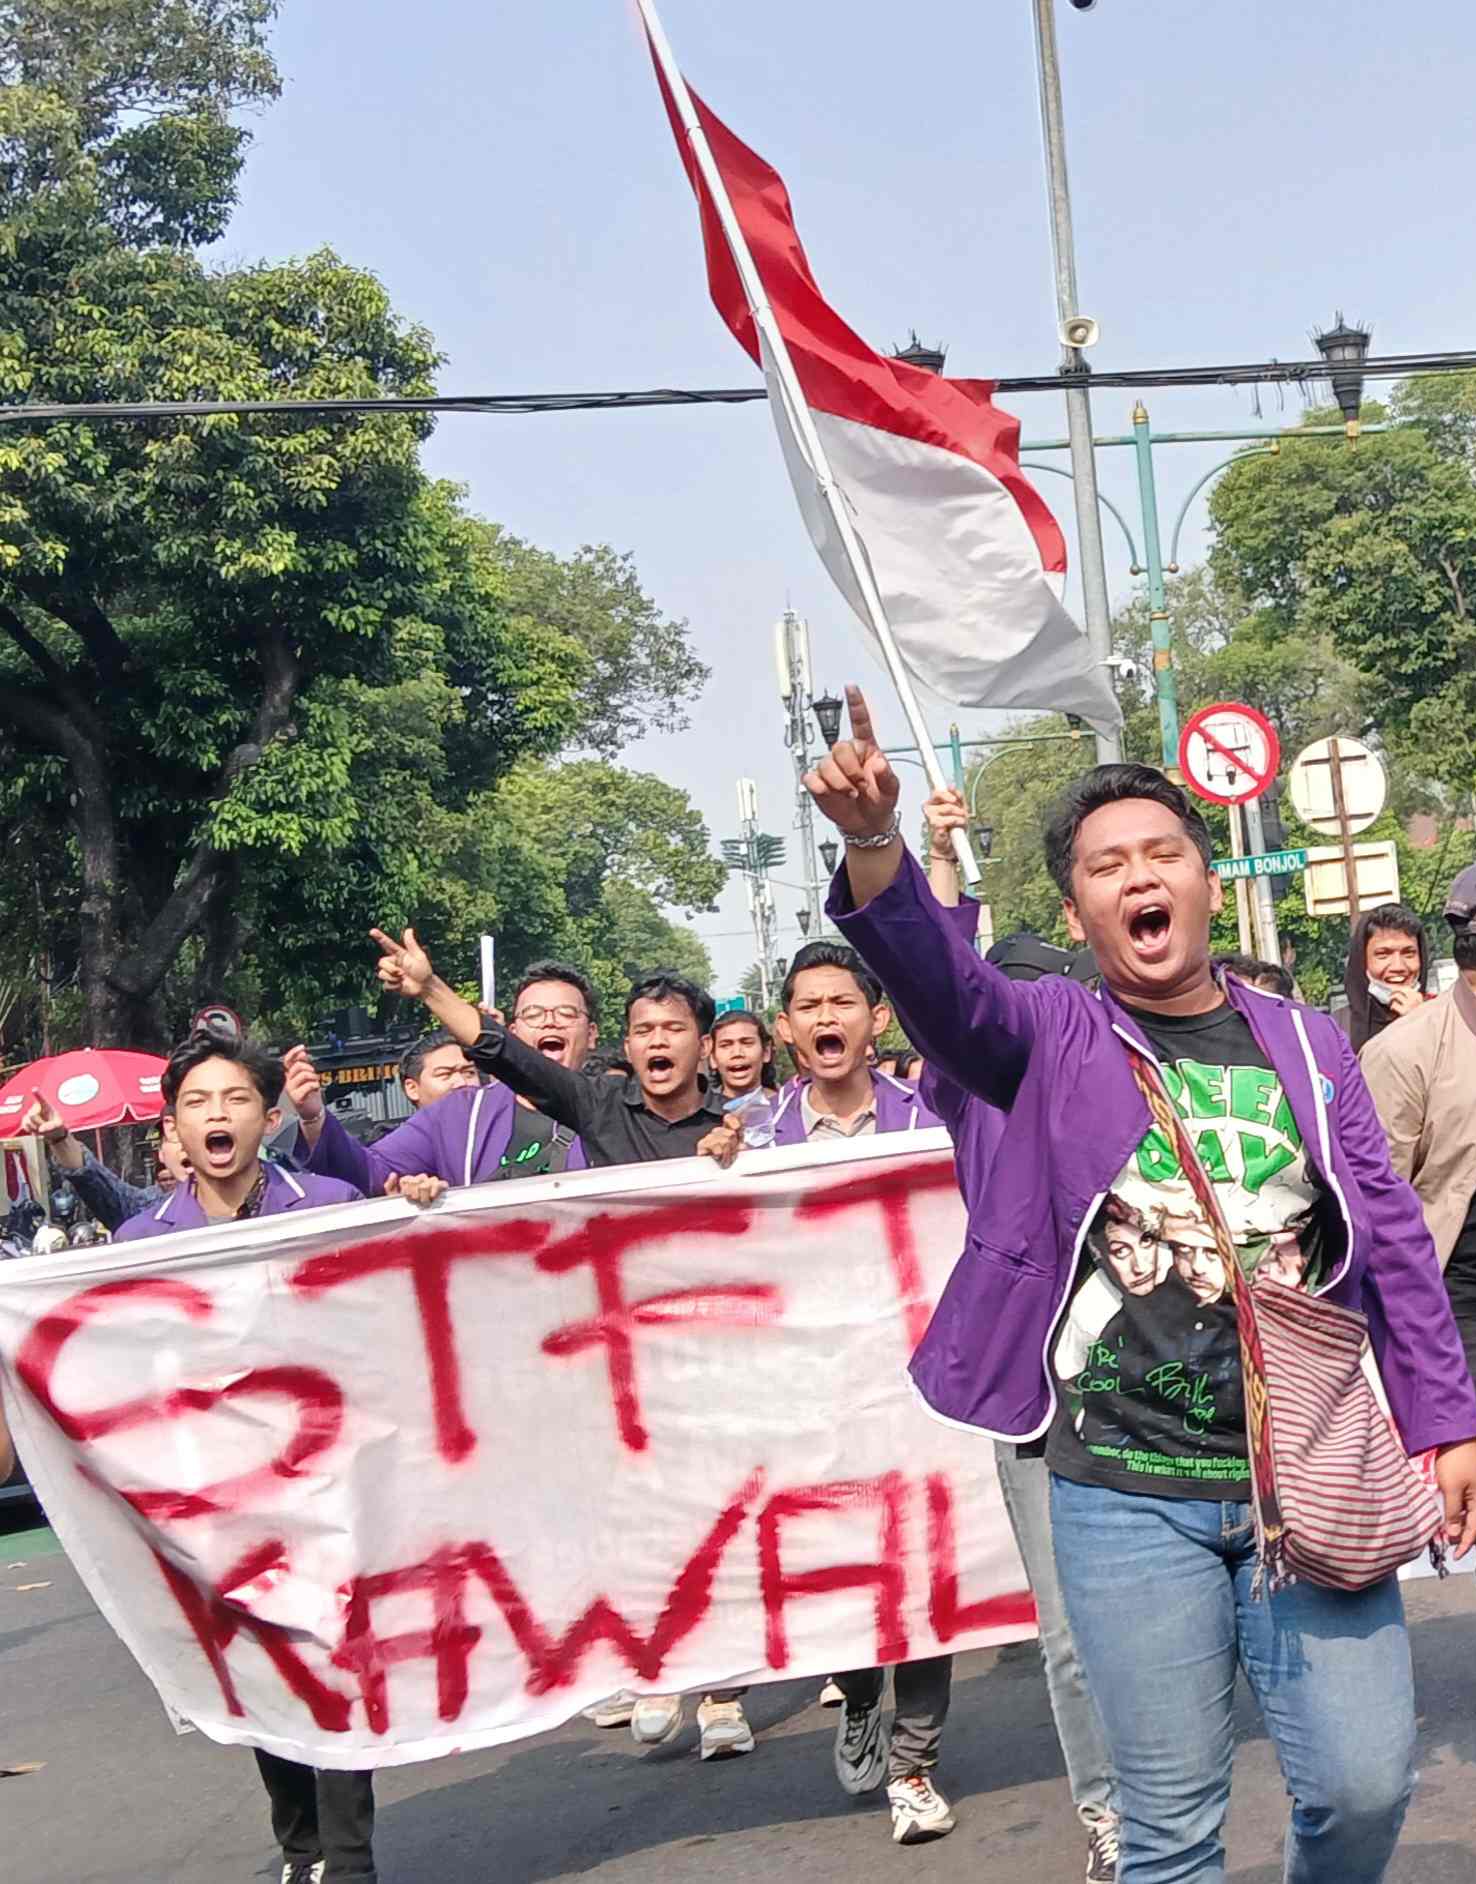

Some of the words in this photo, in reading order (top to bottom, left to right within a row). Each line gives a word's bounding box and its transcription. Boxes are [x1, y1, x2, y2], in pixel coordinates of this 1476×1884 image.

[1254, 853, 1304, 876] BONJOL
[1135, 1129, 1297, 1195] DAY
[152, 1464, 1038, 1736] KAWAL
